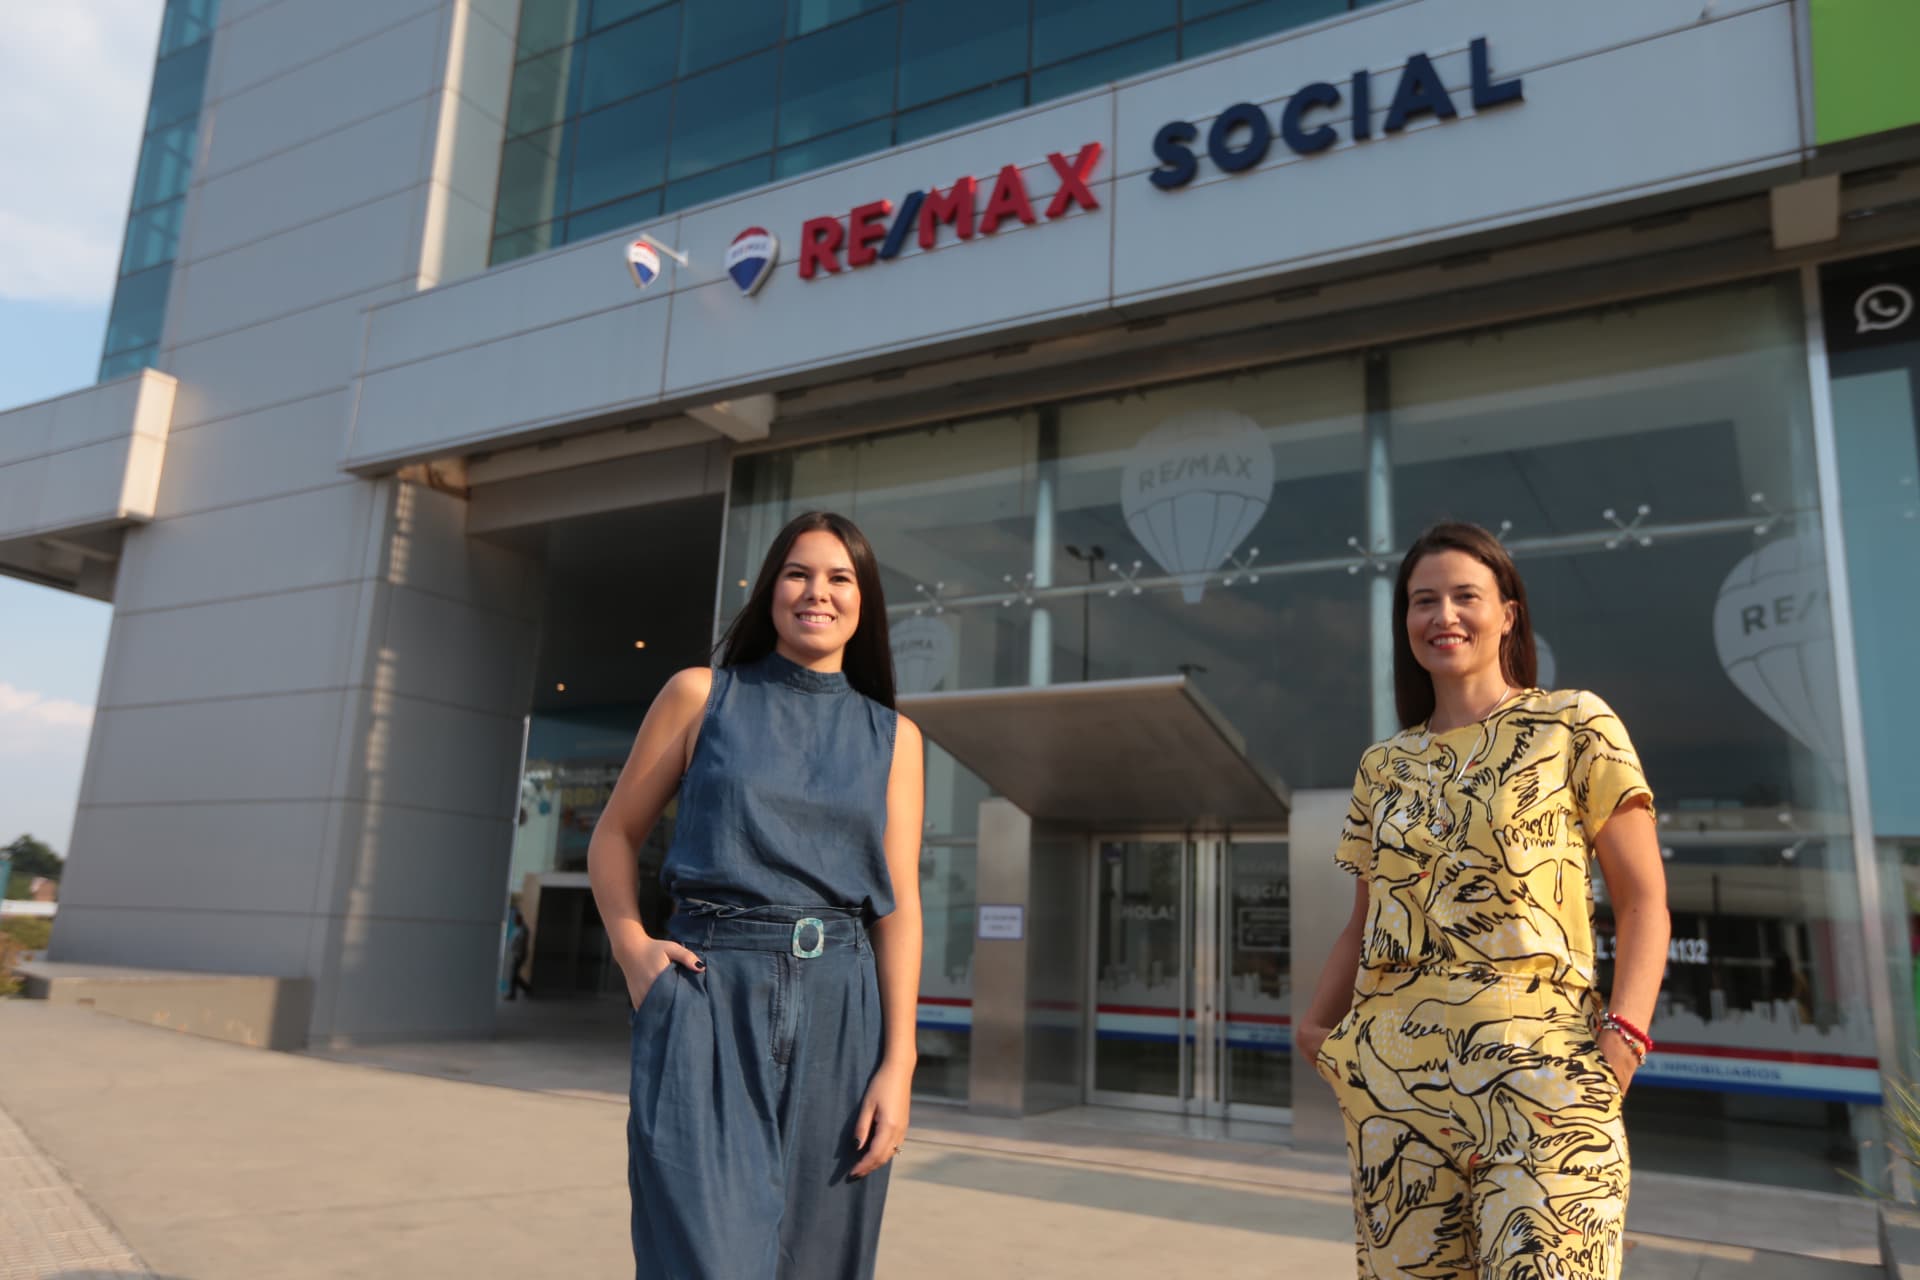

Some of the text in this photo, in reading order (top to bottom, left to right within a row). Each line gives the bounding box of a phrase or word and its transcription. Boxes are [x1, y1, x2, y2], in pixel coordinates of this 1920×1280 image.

[798, 36, 1526, 280] RE/MAX SOCIAL
[1137, 451, 1253, 494] RE/MAX
[1740, 589, 1829, 636] RE/
